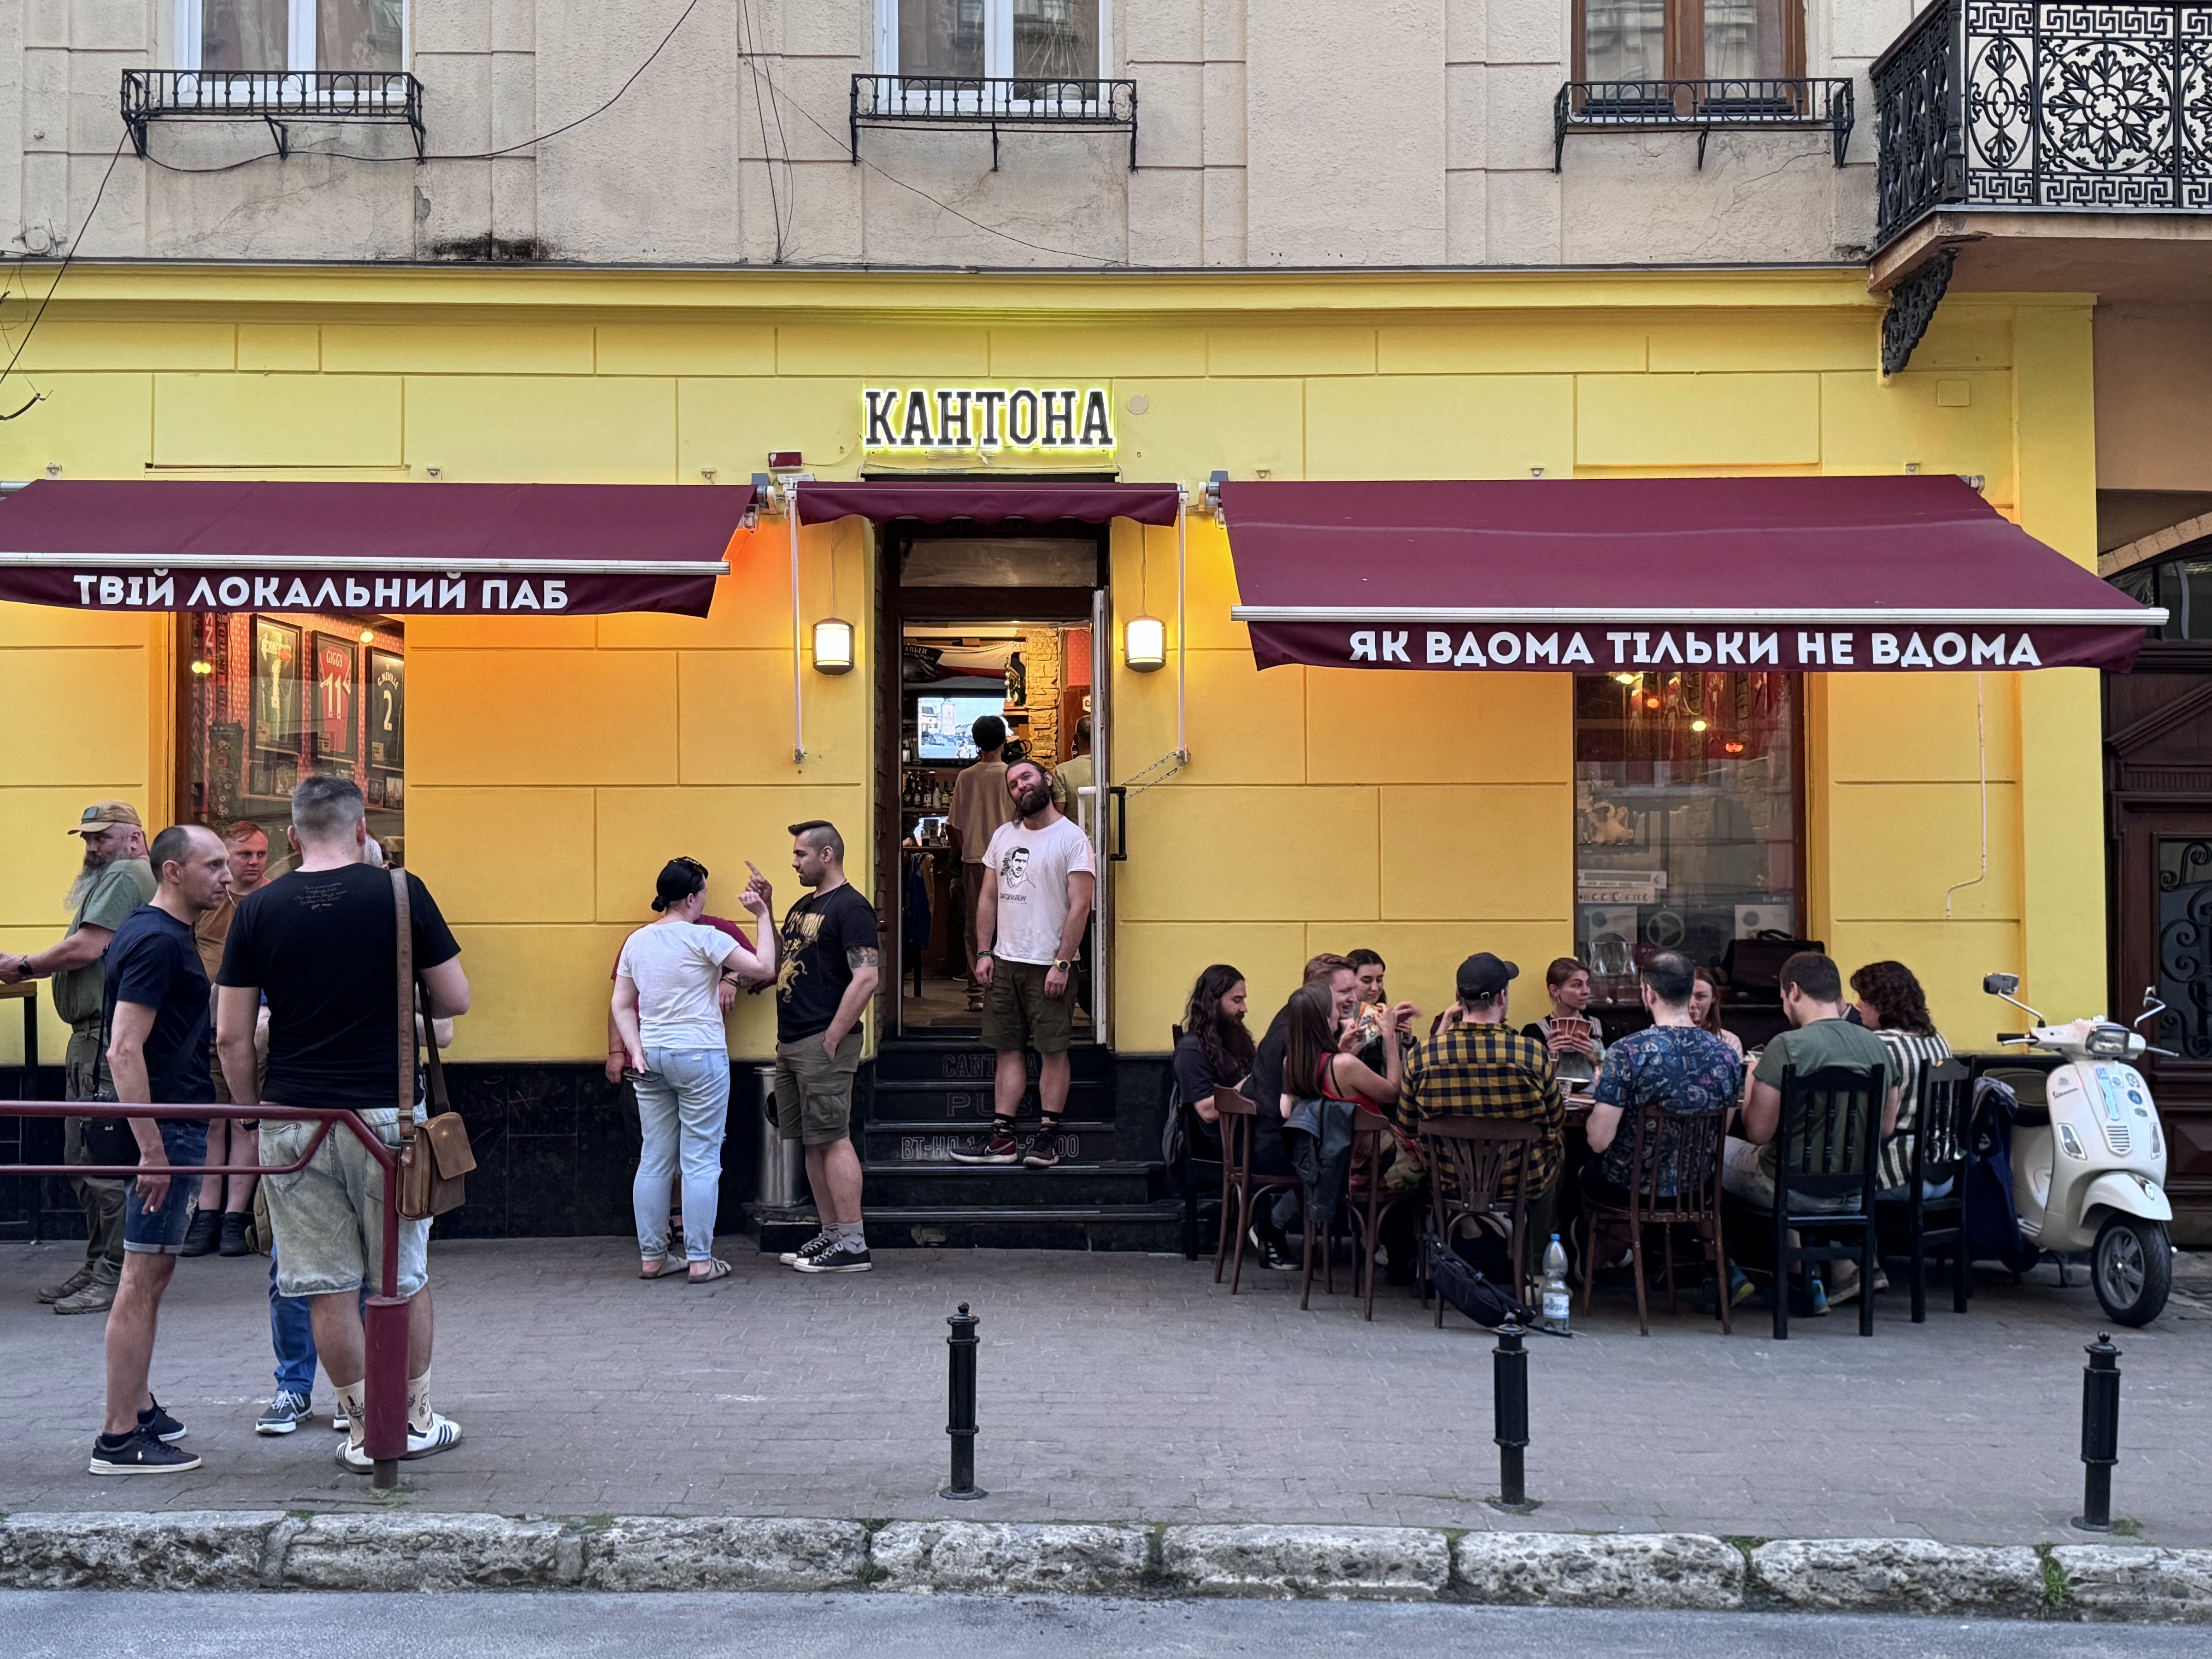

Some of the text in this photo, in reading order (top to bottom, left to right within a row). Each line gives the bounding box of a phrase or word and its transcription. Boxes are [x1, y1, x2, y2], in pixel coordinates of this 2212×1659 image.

[865, 389, 1114, 446] КАНТОНА
[73, 568, 568, 610] ТВІЙ ЛОКАЛЬНИЙ ПАБ
[326, 650, 343, 668] GIGGS
[1349, 630, 2043, 668] ЯК ВДОМА ТІЛЬКИ НЕ ВДОМА
[383, 690, 393, 732] 2
[942, 1053, 1039, 1078] CANTA
